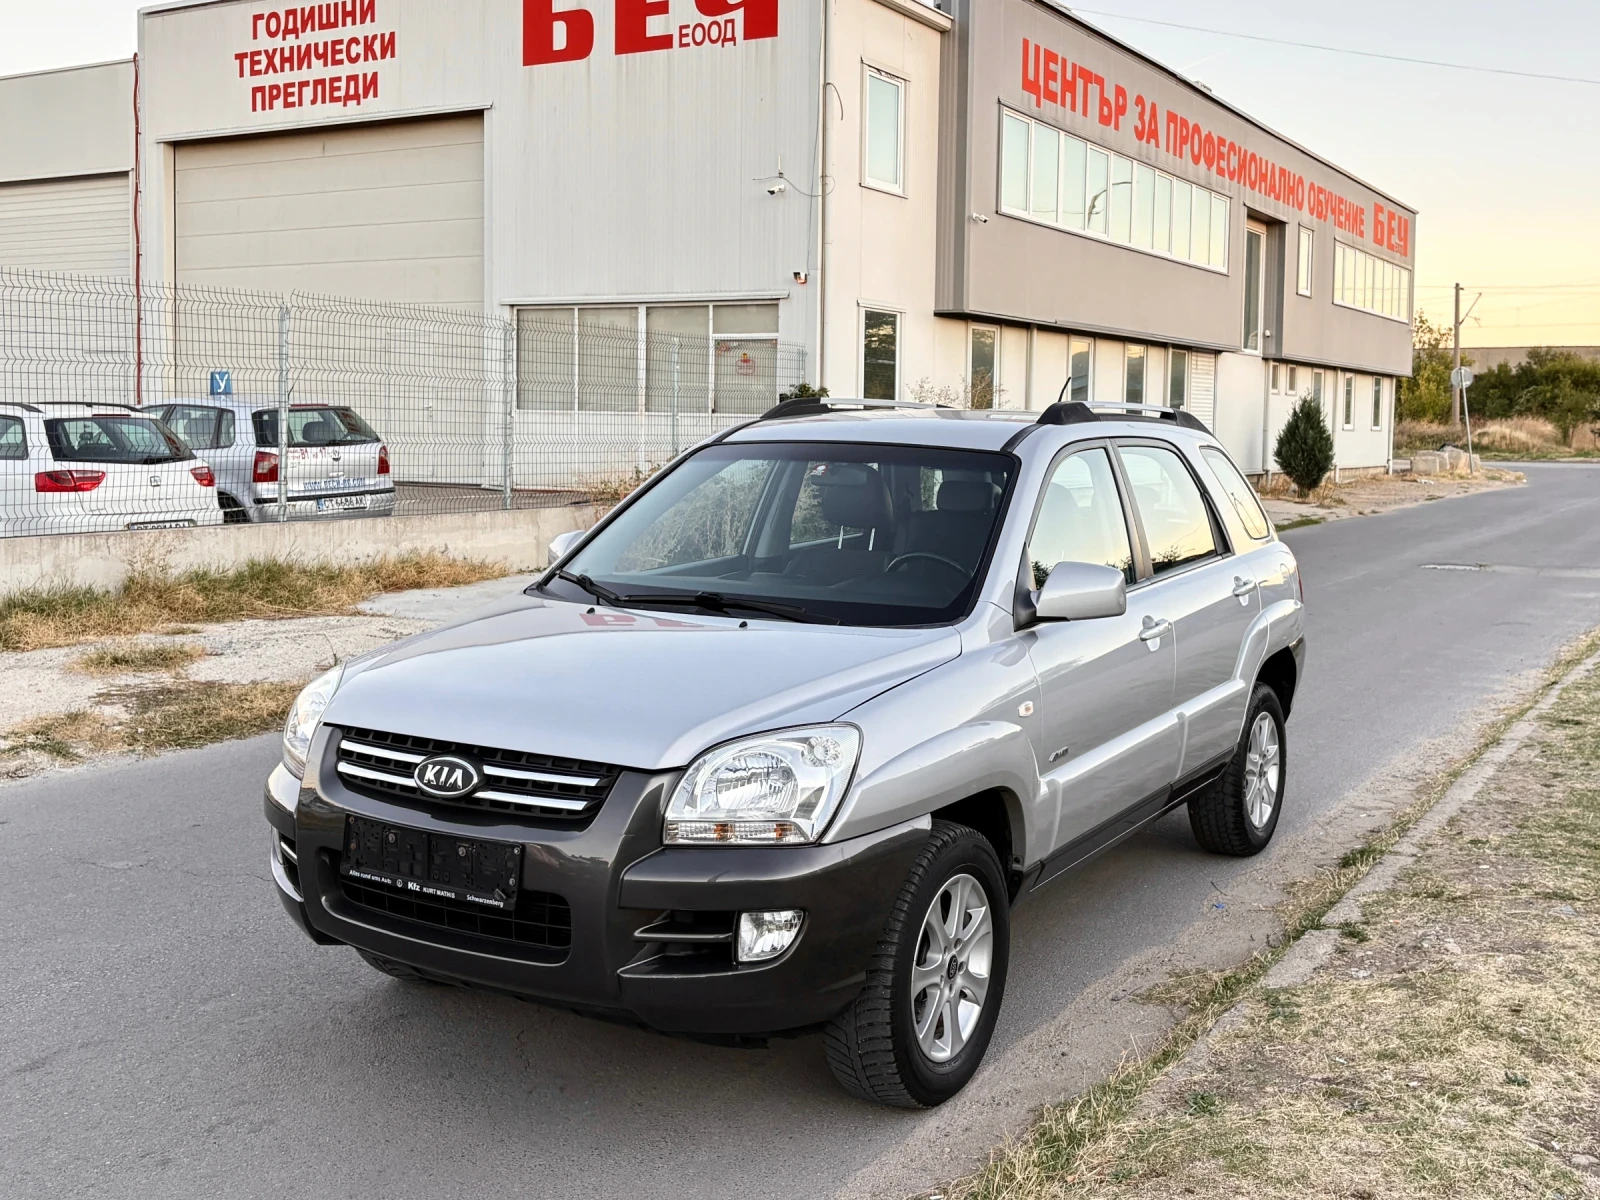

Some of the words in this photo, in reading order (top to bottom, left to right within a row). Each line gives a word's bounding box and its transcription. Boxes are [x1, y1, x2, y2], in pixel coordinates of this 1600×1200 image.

[252, 0, 377, 40] ГОДИШНИ
[678, 18, 737, 49] ЕООД
[234, 31, 397, 78] ТЕХНИЧЕСКИ
[251, 71, 379, 112] ПРЕГЛЕДИ
[1021, 37, 1128, 132] ЦЕНТЪР
[1133, 94, 1161, 149] ЗА
[1165, 109, 1306, 212] ПРОФЕСИОНАЛНО
[1307, 181, 1366, 239] ОБУЧЕНИЕ
[1373, 202, 1409, 258] БЕЧ
[424, 764, 463, 790] KIA
[349, 869, 360, 877] Alles
[360, 872, 371, 880] rund
[407, 881, 421, 892] Kfz
[422, 886, 437, 895] KURT
[436, 889, 456, 899] MATHIS
[466, 894, 504, 908] Schwarzenberg
